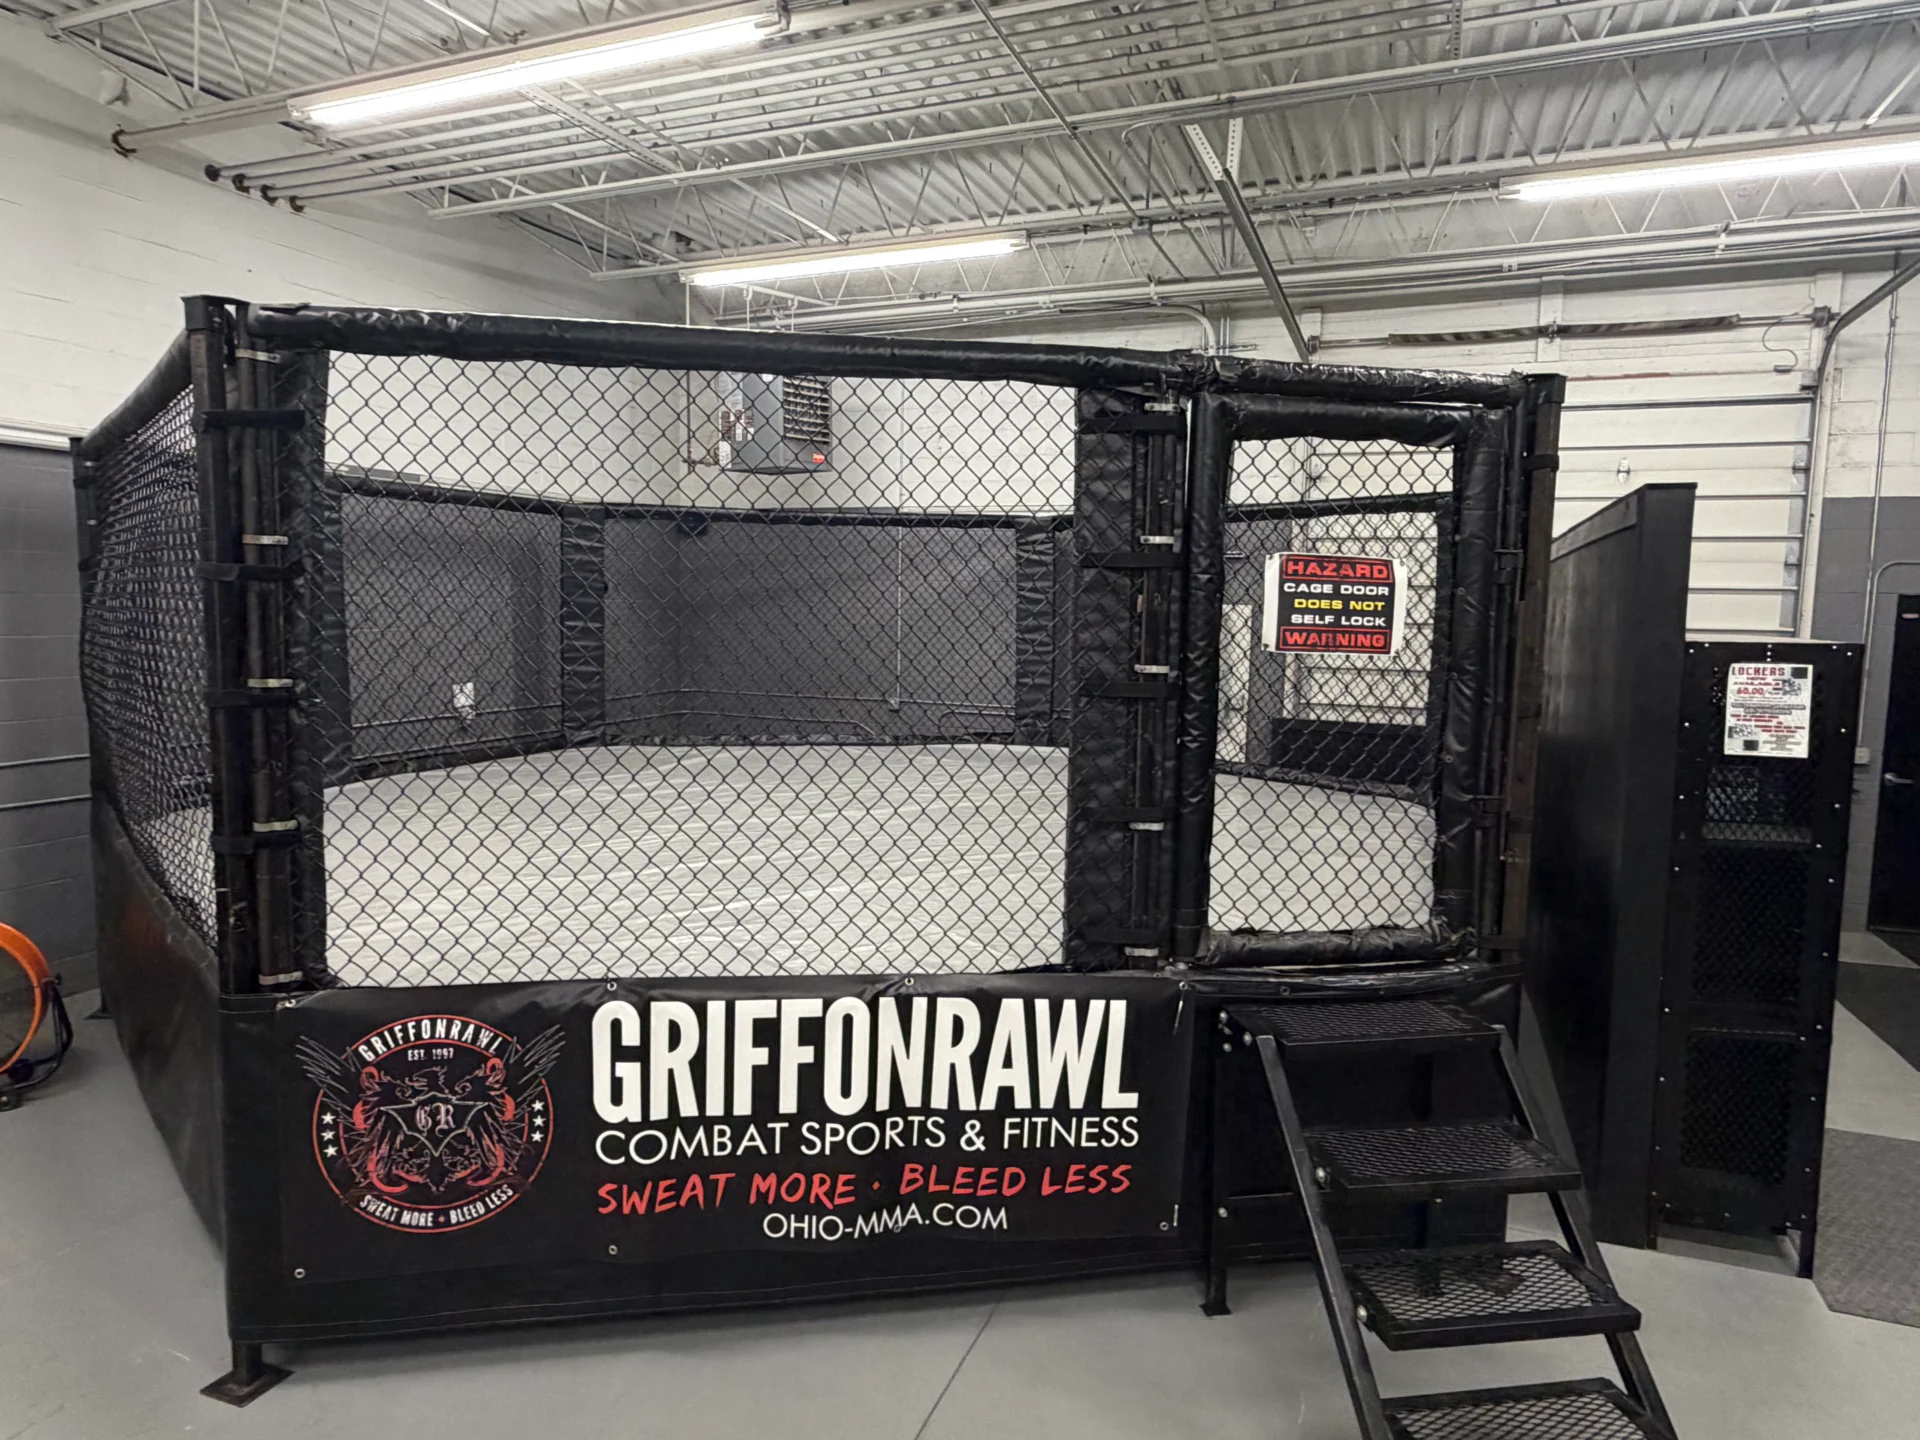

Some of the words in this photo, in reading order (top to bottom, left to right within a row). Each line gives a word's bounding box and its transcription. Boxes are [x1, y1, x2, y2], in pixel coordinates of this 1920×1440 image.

[1287, 561, 1388, 578] HAZARD
[1283, 582, 1334, 594] CAGE
[1340, 584, 1390, 596] DOOR
[1294, 598, 1343, 610] DOES
[1349, 600, 1386, 611] NOT
[1290, 614, 1335, 625] SELF
[1340, 615, 1387, 627] LOCK
[1285, 632, 1385, 647] WARNING
[1731, 667, 1785, 676] LOCKERS
[358, 1019, 502, 1062] GRIFFONRAWL
[592, 997, 1138, 1123] GRIFFONRAWL
[595, 1122, 789, 1165] COMBAT
[800, 1115, 946, 1156] SPORTS
[959, 1119, 986, 1152] &
[1003, 1115, 1139, 1150] FITNESS
[597, 1173, 736, 1215] SWEAT
[749, 1172, 856, 1210] MORE
[899, 1163, 1026, 1197] BLEED
[1041, 1164, 1132, 1196] LESS
[359, 1194, 399, 1222] SWEAT
[400, 1210, 434, 1227] MORE
[449, 1201, 486, 1224] BLEED
[485, 1183, 514, 1209] LESS
[763, 1203, 1008, 1241] OHIO-MMA.COM
